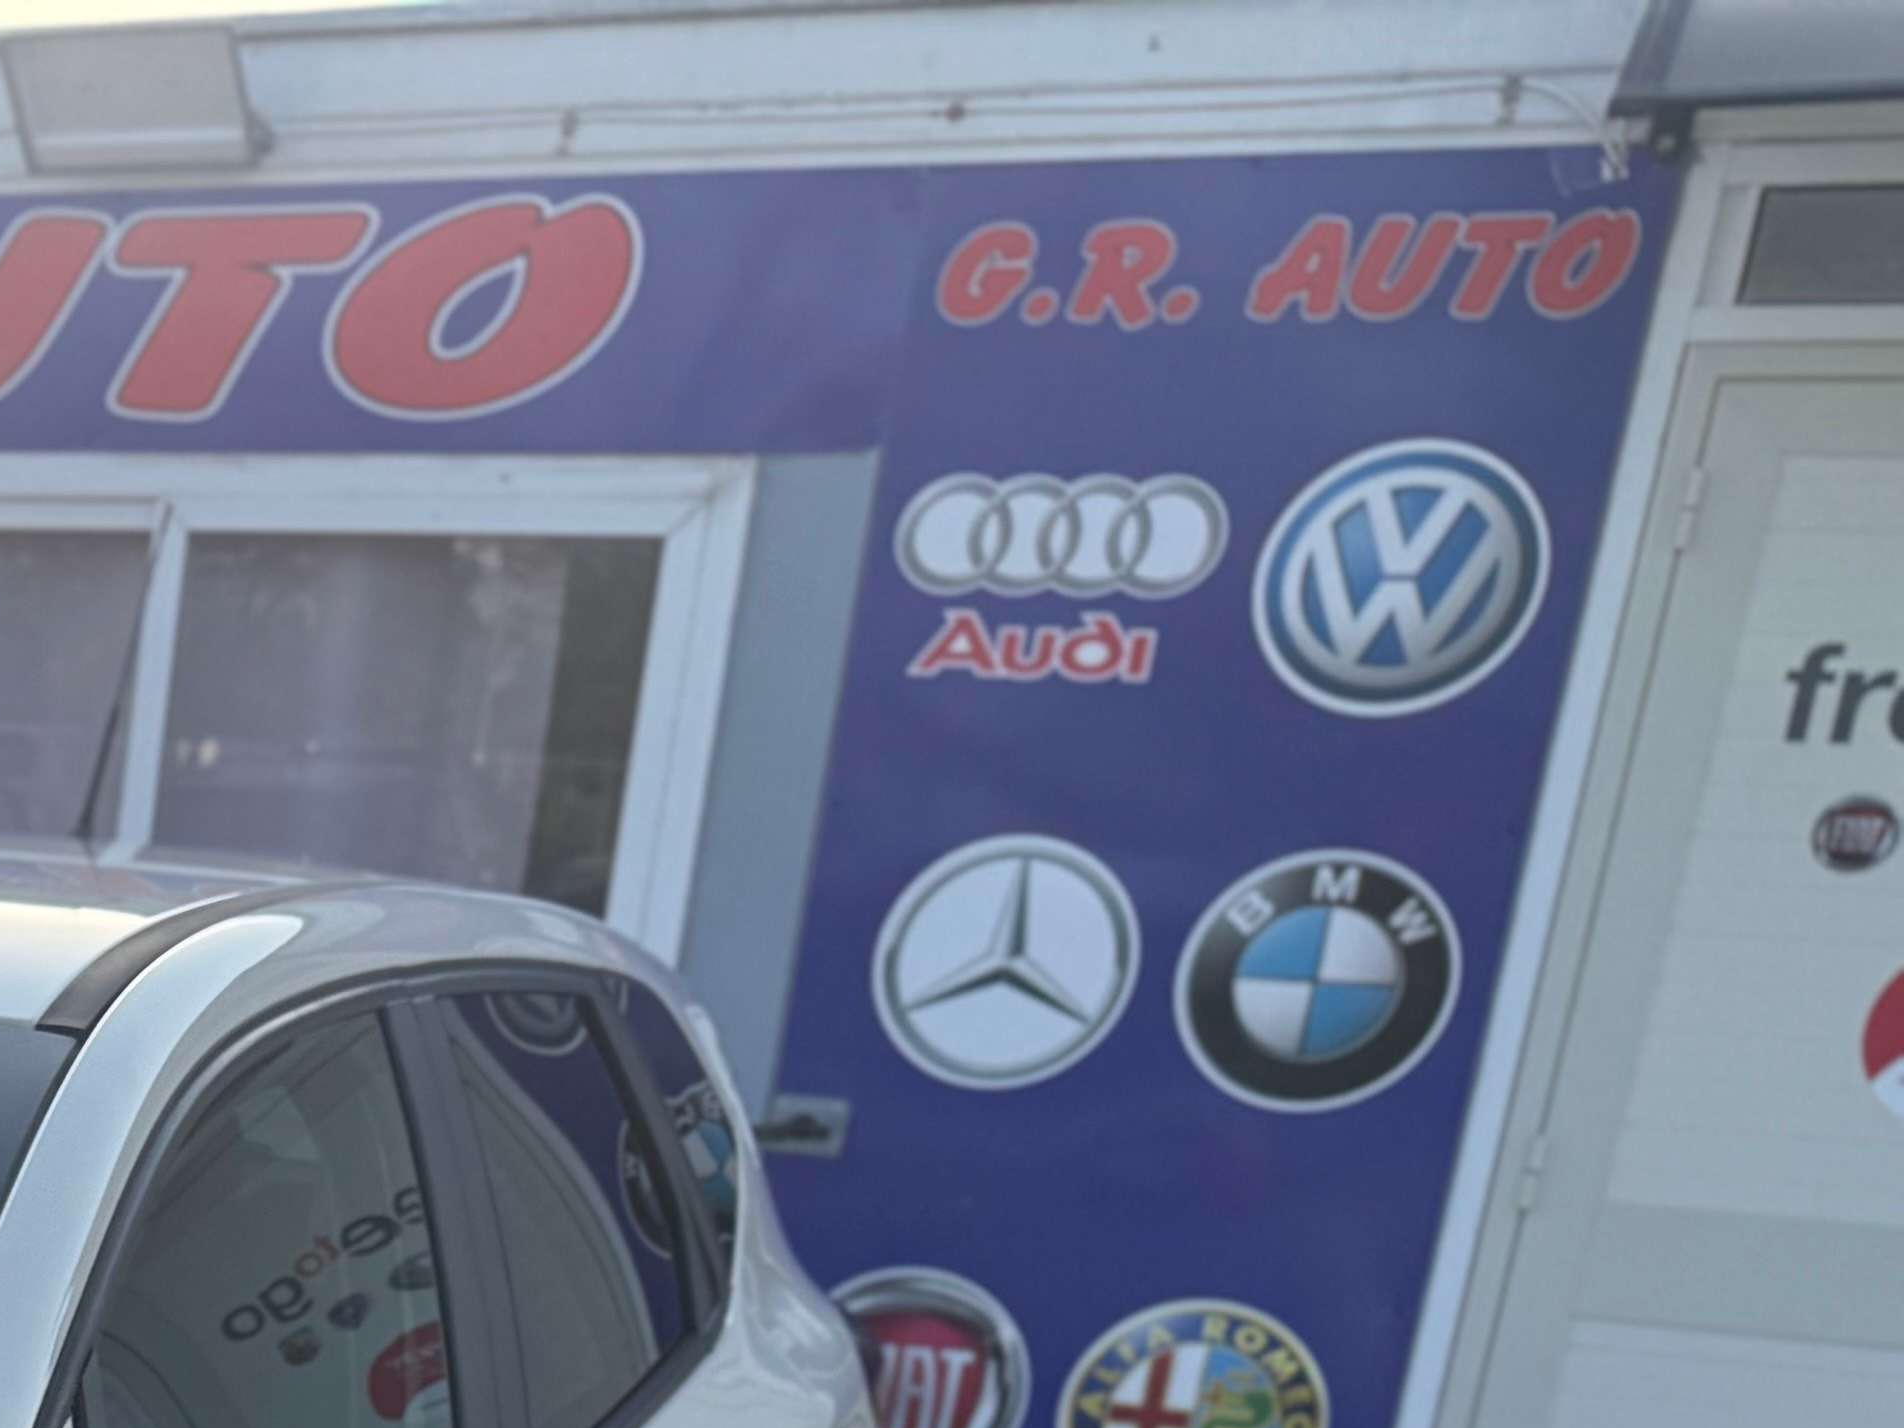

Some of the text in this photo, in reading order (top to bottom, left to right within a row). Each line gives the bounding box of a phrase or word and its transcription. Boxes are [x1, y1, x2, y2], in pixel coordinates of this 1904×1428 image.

[935, 207, 1641, 331] G.R. AUTO
[905, 608, 1158, 684] Audi
[1226, 862, 1437, 948] BMW
